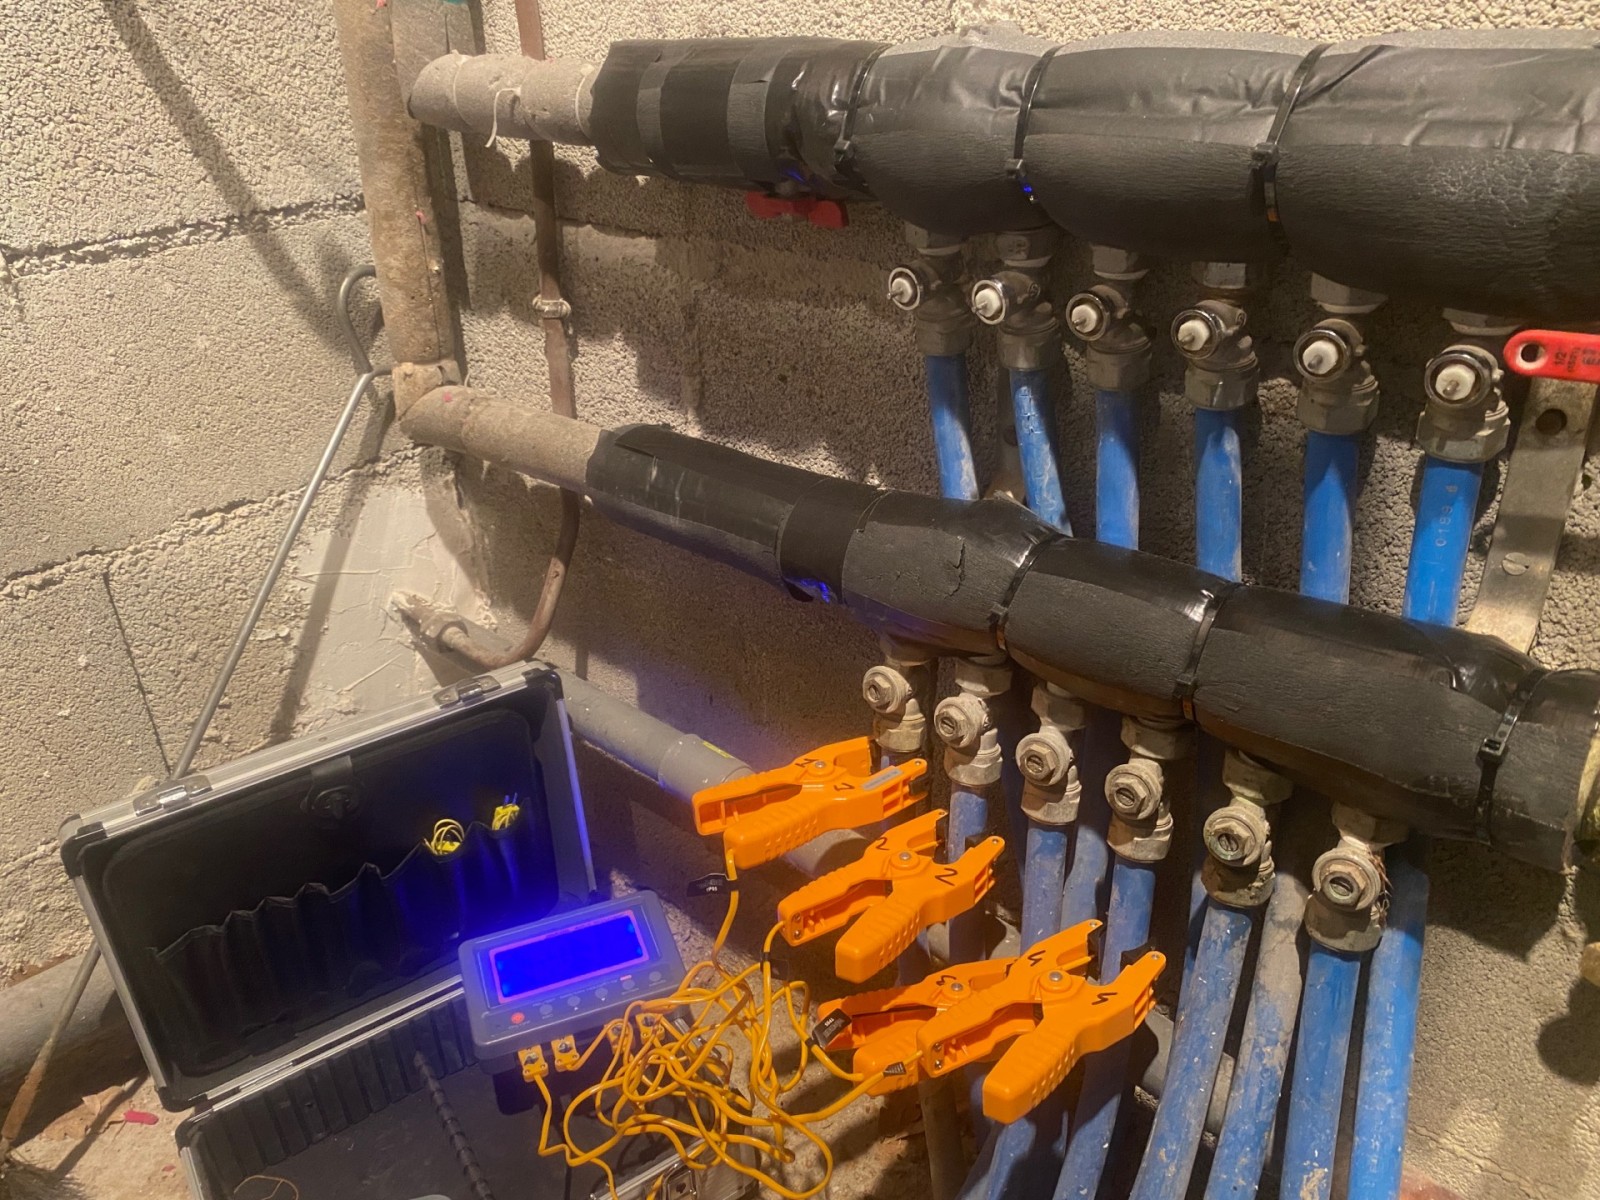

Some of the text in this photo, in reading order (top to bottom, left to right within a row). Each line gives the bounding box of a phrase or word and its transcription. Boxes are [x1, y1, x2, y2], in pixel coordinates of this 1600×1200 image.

[875, 836, 890, 851] 2
[934, 867, 958, 887] 2
[1027, 950, 1046, 967] 4
[935, 974, 957, 986] 3
[1091, 992, 1119, 1006] 4
